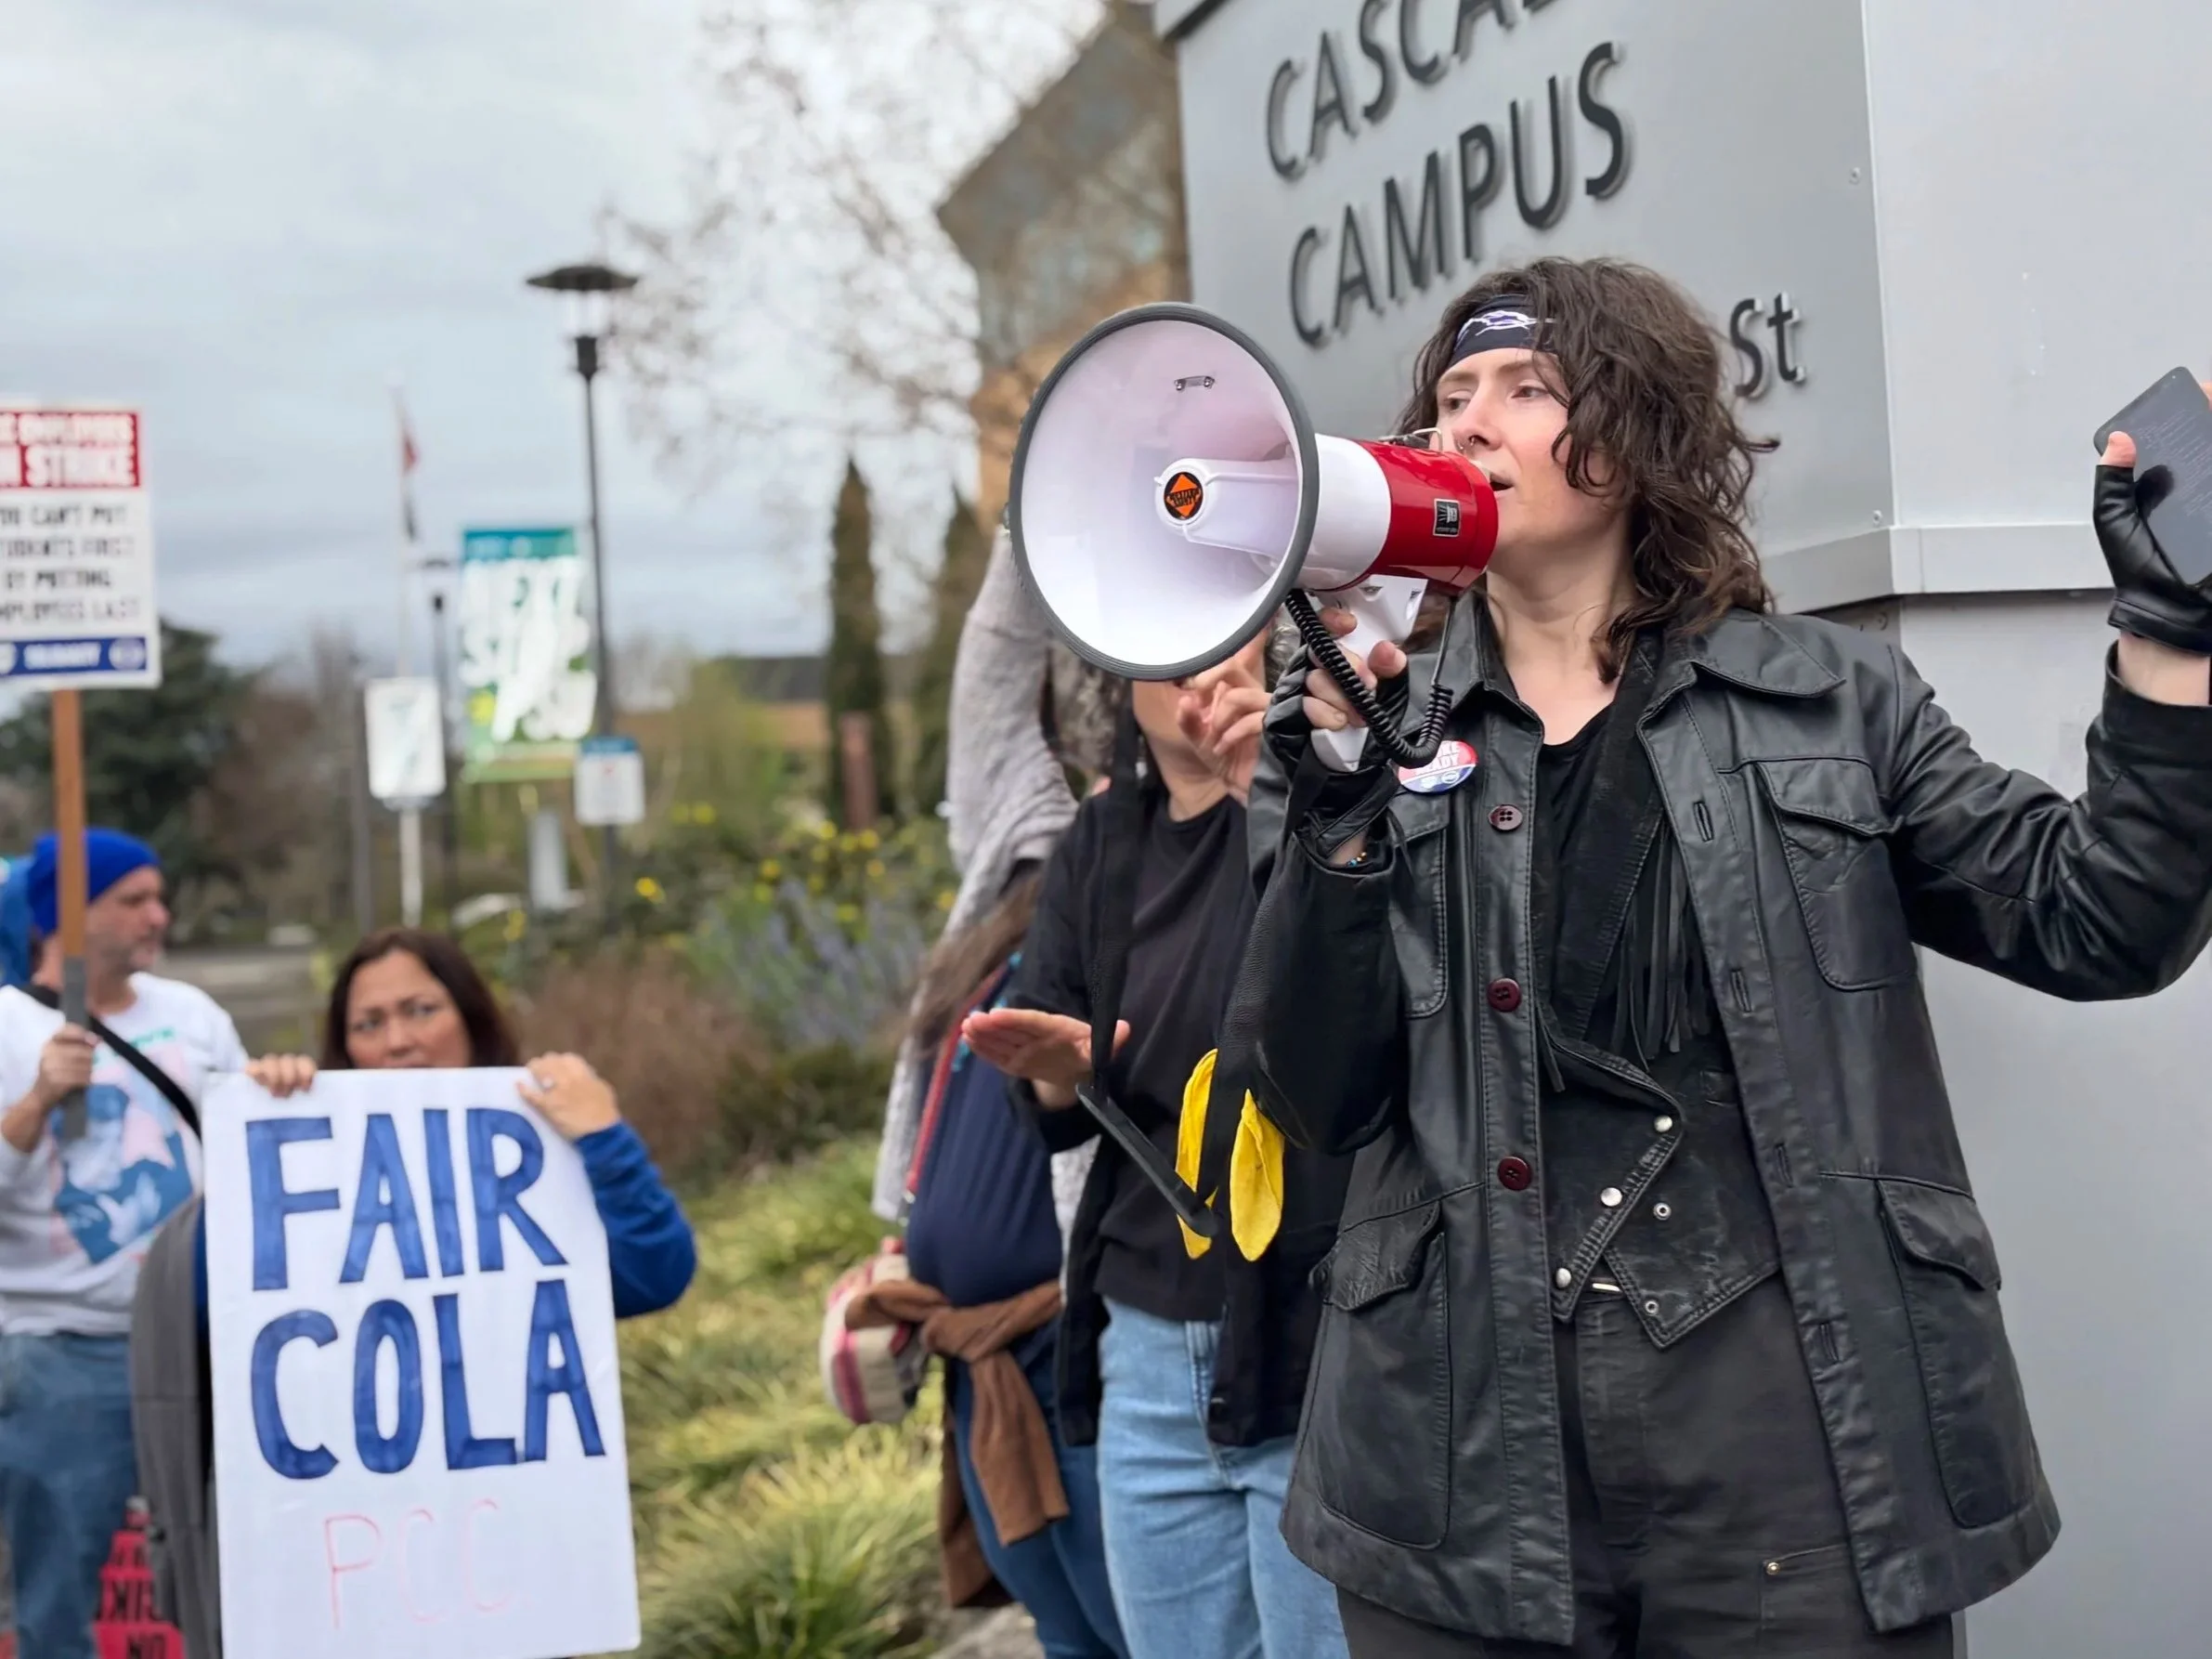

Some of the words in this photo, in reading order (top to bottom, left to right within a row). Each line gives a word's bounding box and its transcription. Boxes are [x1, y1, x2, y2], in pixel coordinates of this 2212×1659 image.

[1290, 41, 1627, 346] CAMPUS
[245, 1107, 569, 1292] FAIR
[250, 1278, 607, 1480] COLA
[322, 1497, 520, 1629] PCC
